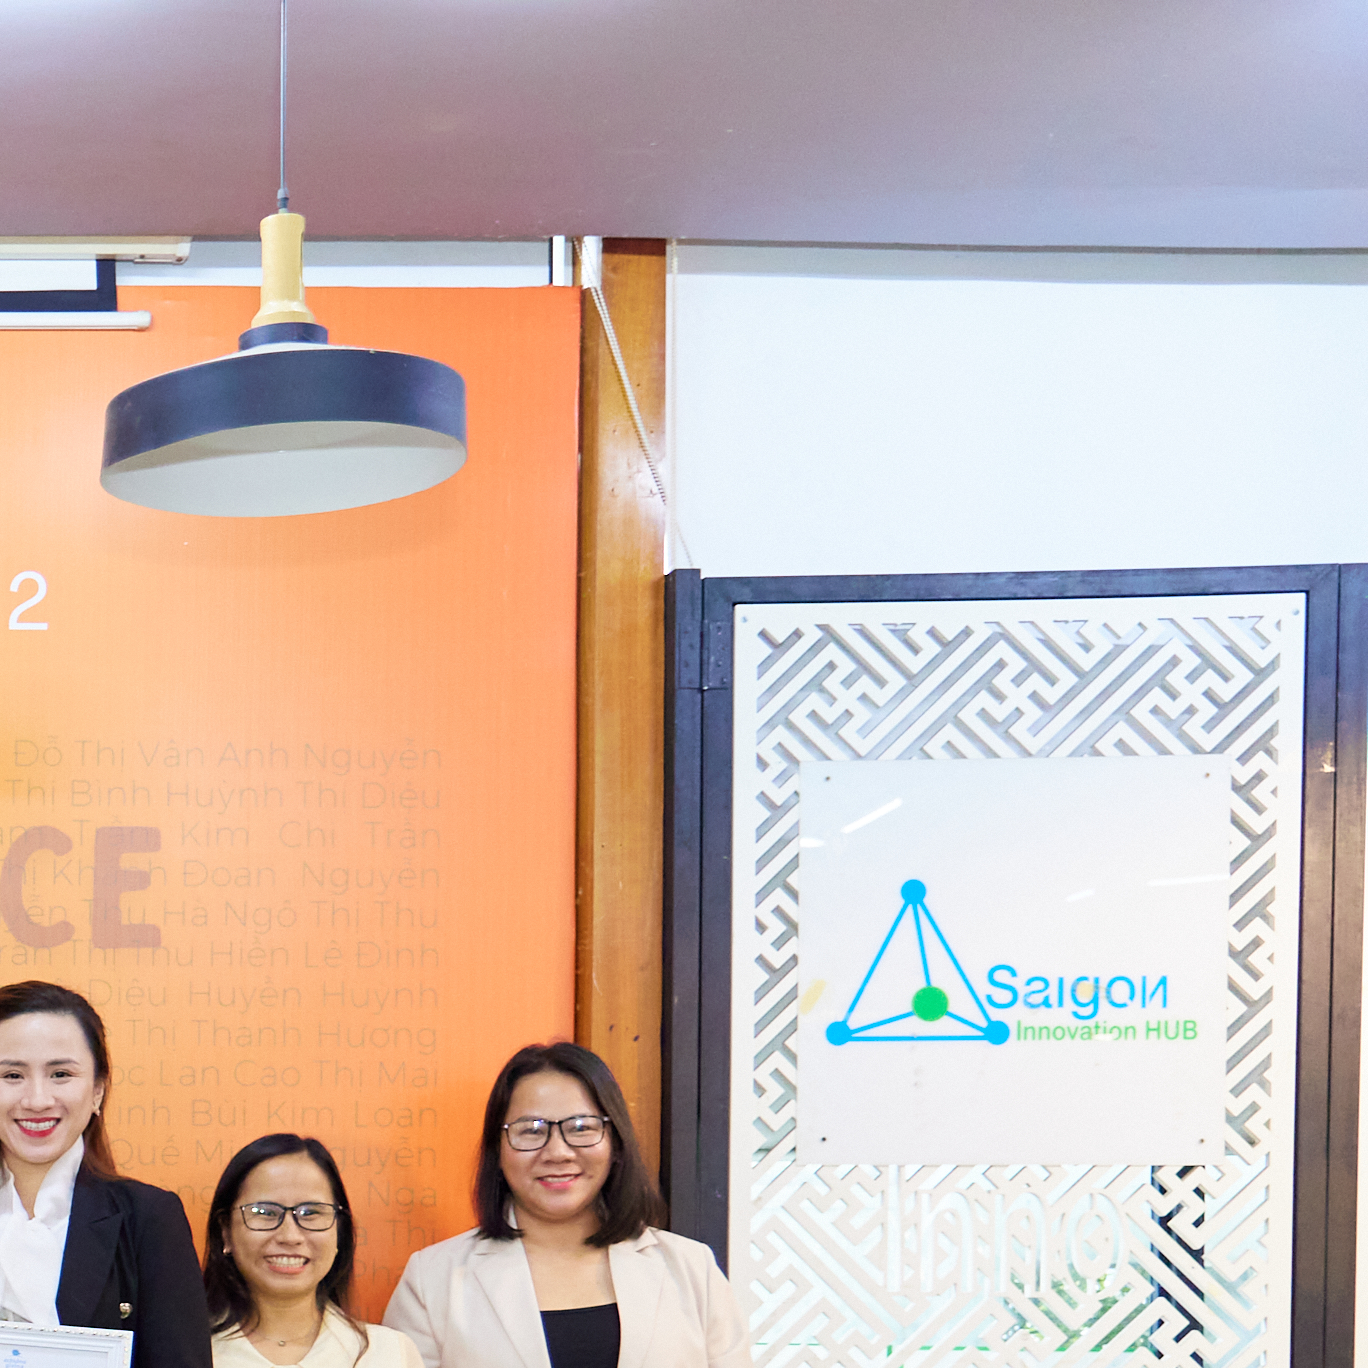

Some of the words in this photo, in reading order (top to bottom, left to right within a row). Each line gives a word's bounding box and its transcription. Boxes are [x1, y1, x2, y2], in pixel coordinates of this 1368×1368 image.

[7, 570, 49, 631] 2
[217, 741, 289, 769] Anh
[182, 820, 250, 848] Kim
[279, 819, 336, 848] Chi
[183, 858, 276, 888] Đoan
[224, 898, 297, 936] Ngô
[374, 900, 438, 929] Thu
[304, 938, 343, 969] Lê
[191, 1018, 302, 1048] Thanh
[1016, 1019, 1137, 1041] Innovation
[1145, 1019, 1198, 1041] HUB
[159, 1060, 220, 1088] Lan
[234, 1059, 302, 1088] Cao
[378, 1060, 439, 1089] Mai
[117, 1100, 171, 1127] inh
[267, 1100, 334, 1127] Kim
[354, 1100, 438, 1128] Loan
[368, 1179, 438, 1213] Nga
